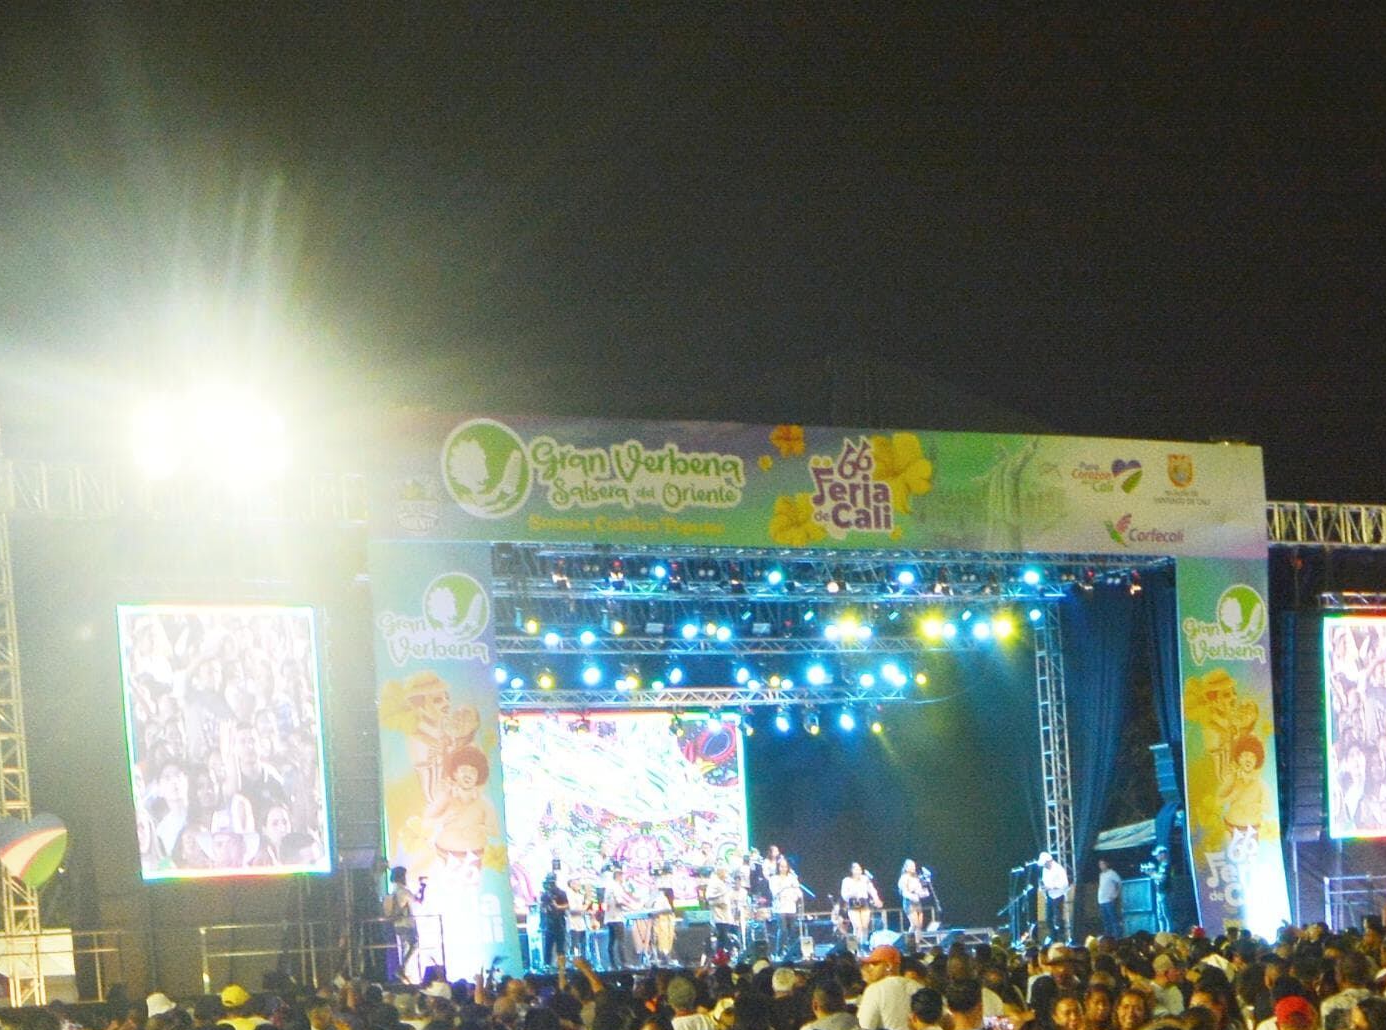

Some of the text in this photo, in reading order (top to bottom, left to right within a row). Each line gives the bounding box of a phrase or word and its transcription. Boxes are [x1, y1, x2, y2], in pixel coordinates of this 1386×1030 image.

[531, 440, 743, 484] Gran Verbena
[838, 441, 872, 480] 66
[551, 477, 630, 506] Salsera
[663, 482, 737, 508] Oriente
[812, 465, 890, 508] Feria
[814, 503, 892, 529] de Cali
[379, 614, 425, 637] Gran
[390, 636, 489, 667] Verbena
[1192, 640, 1265, 664] Verbena
